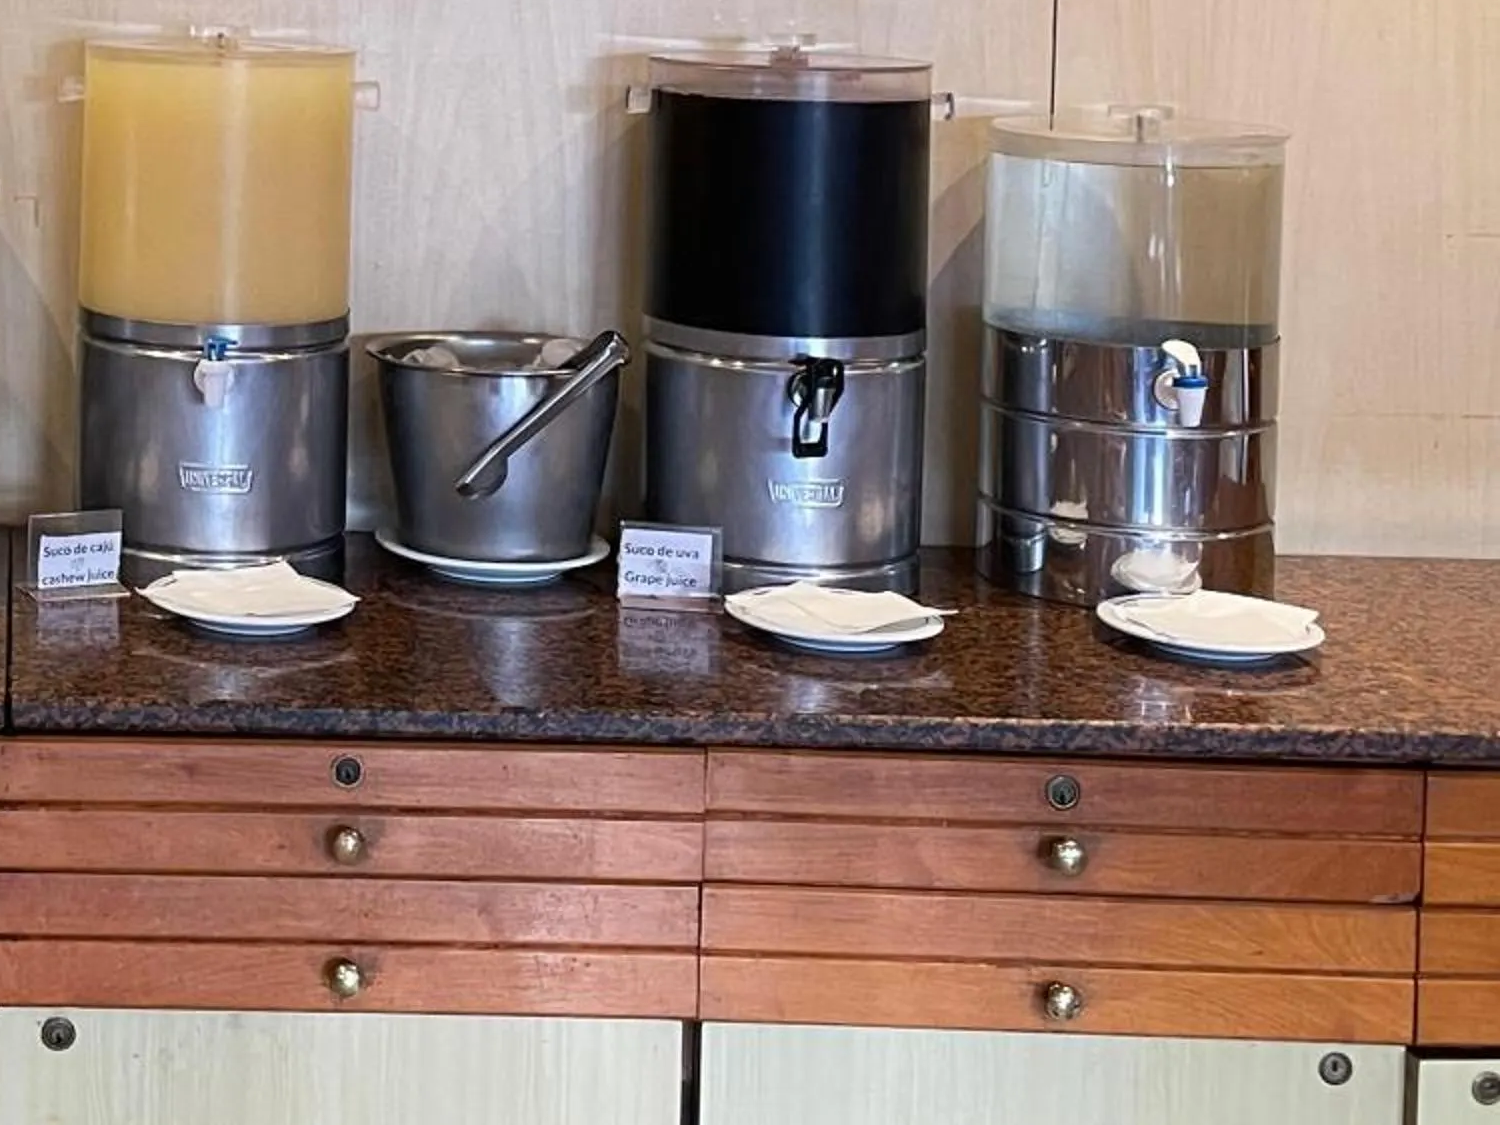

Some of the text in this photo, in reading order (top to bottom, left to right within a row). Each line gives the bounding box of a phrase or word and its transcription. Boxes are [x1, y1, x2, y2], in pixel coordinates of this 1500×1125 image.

[43, 546, 72, 558] Suco
[74, 543, 88, 554] de
[624, 542, 699, 559] Suco de uva
[624, 570, 697, 588] Grape juice
